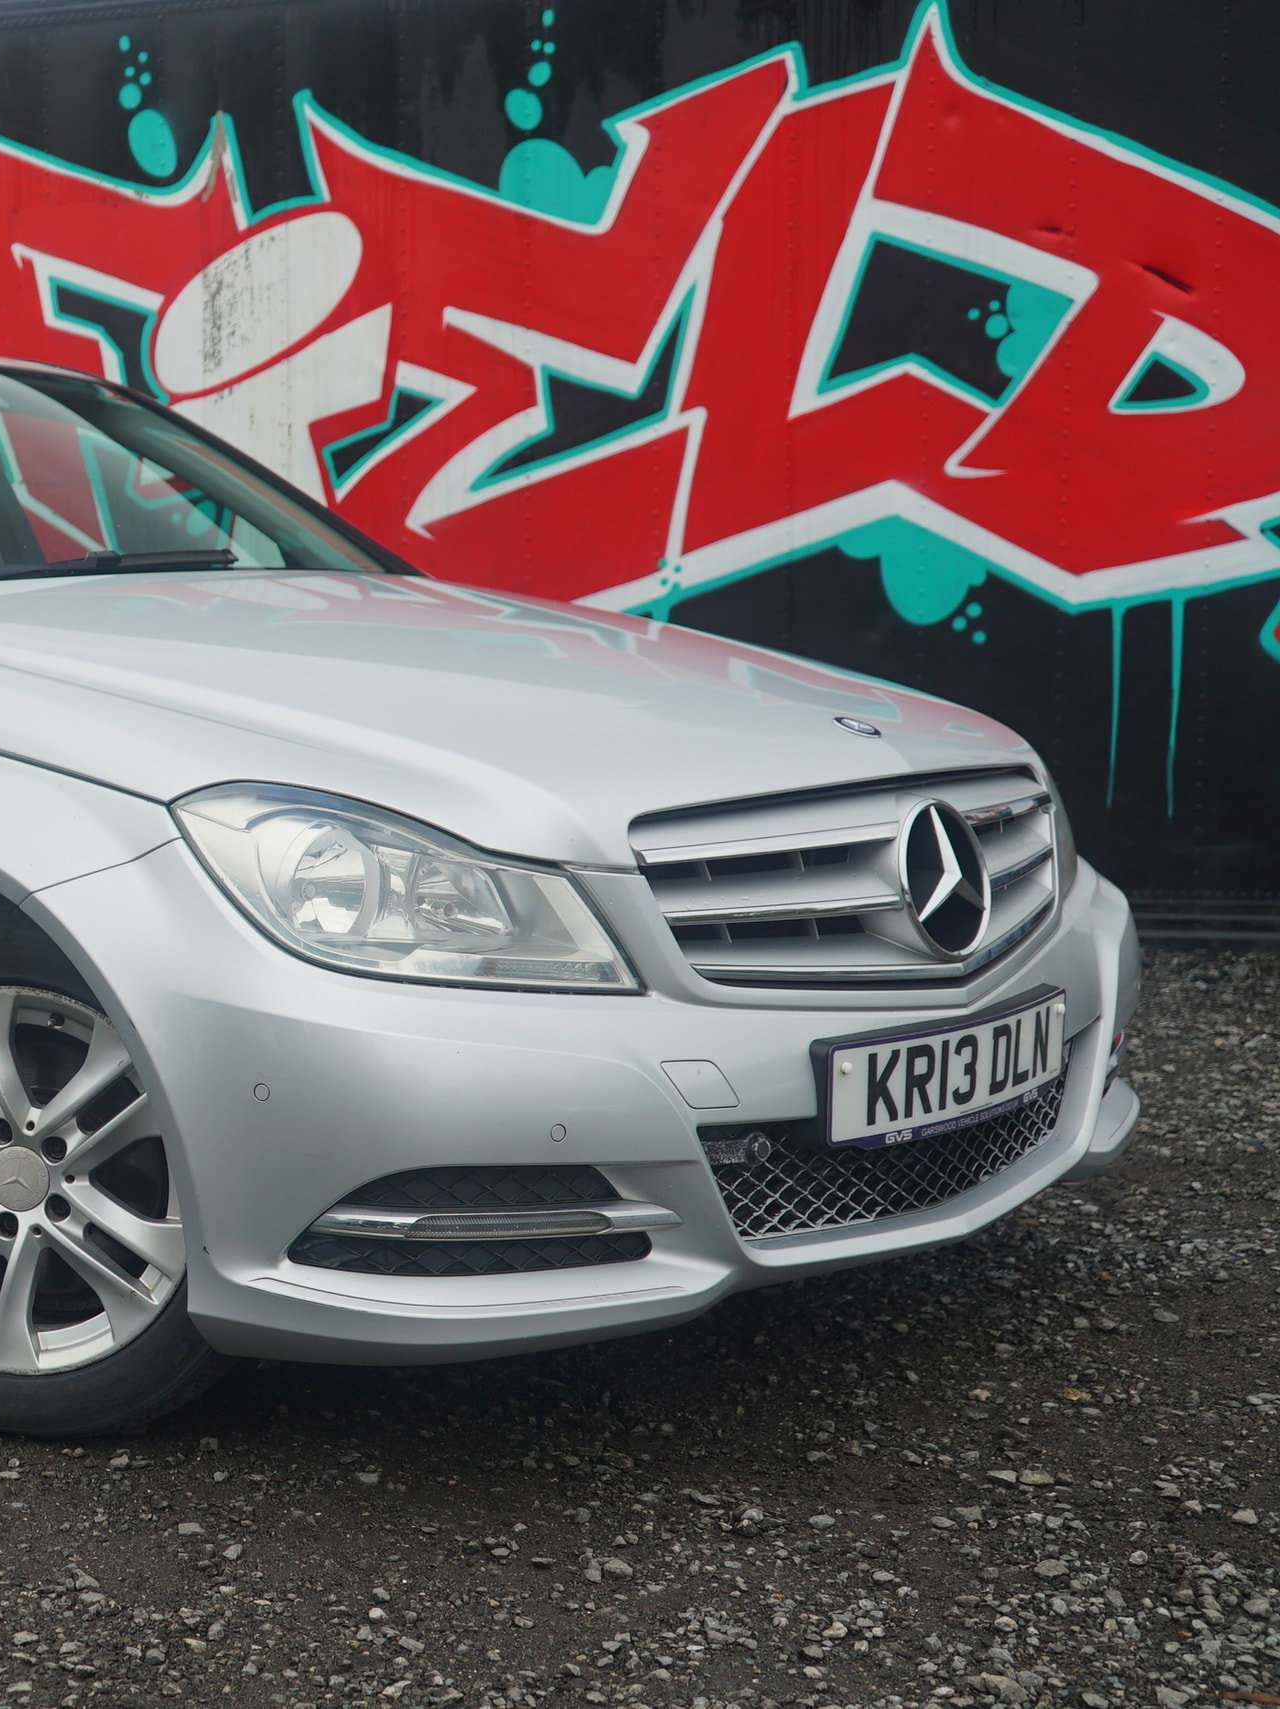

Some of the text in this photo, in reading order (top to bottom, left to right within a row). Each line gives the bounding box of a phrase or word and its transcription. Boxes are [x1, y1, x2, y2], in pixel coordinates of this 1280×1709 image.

[866, 1006, 1051, 1127] KR13 DLN
[885, 1129, 913, 1144] GVS
